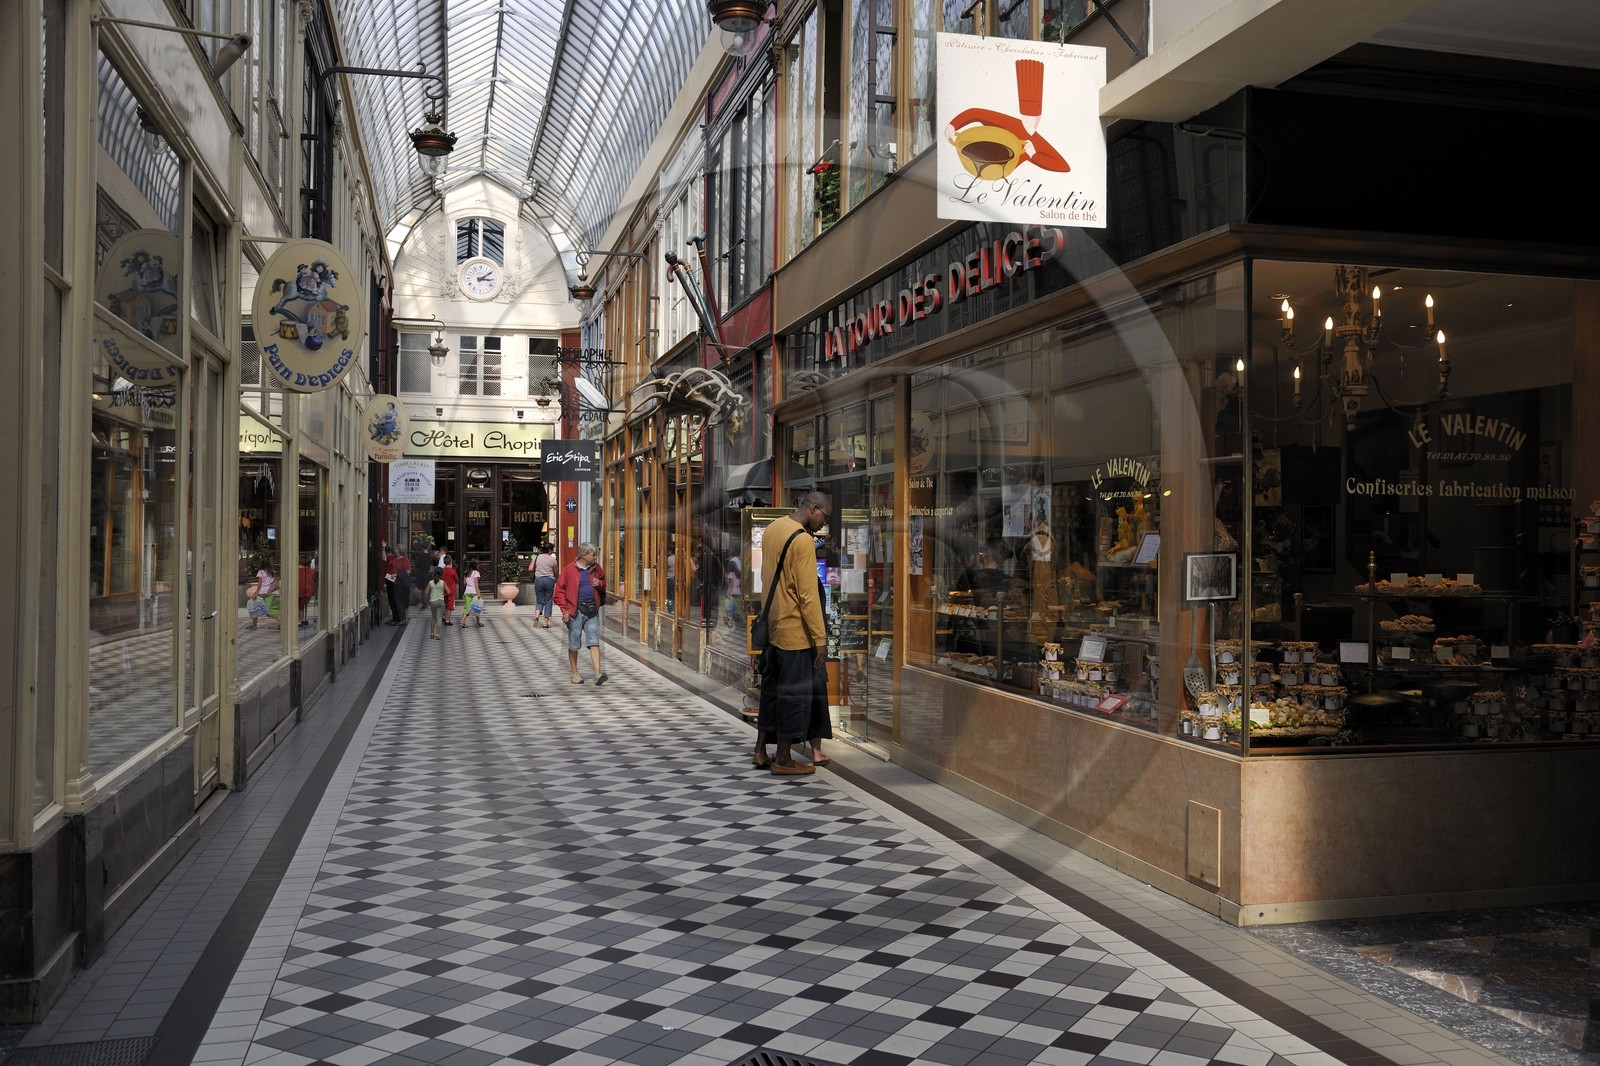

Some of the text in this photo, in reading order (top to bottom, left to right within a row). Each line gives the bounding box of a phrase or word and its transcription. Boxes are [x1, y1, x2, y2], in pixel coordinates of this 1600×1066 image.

[945, 39, 1099, 62] Pâtissier Chocolatier Fabricant
[949, 173, 1098, 212] Le Valentin
[1039, 210, 1098, 222] Salon de thé
[845, 299, 896, 351] TOUR
[899, 273, 942, 328] DES
[948, 223, 1064, 305] DELICES
[263, 342, 293, 381] Pain
[410, 429, 474, 449] Hôtel
[1408, 413, 1528, 452] LE VALENTIN
[546, 450, 591, 468] Eric Stipa
[1091, 457, 1151, 490] LE VALENTIN
[1346, 477, 1577, 501] Confiseries fabrication maison
[412, 510, 445, 521] HOTEL
[468, 510, 489, 518] HOTEL
[514, 511, 545, 522] HOTEL
